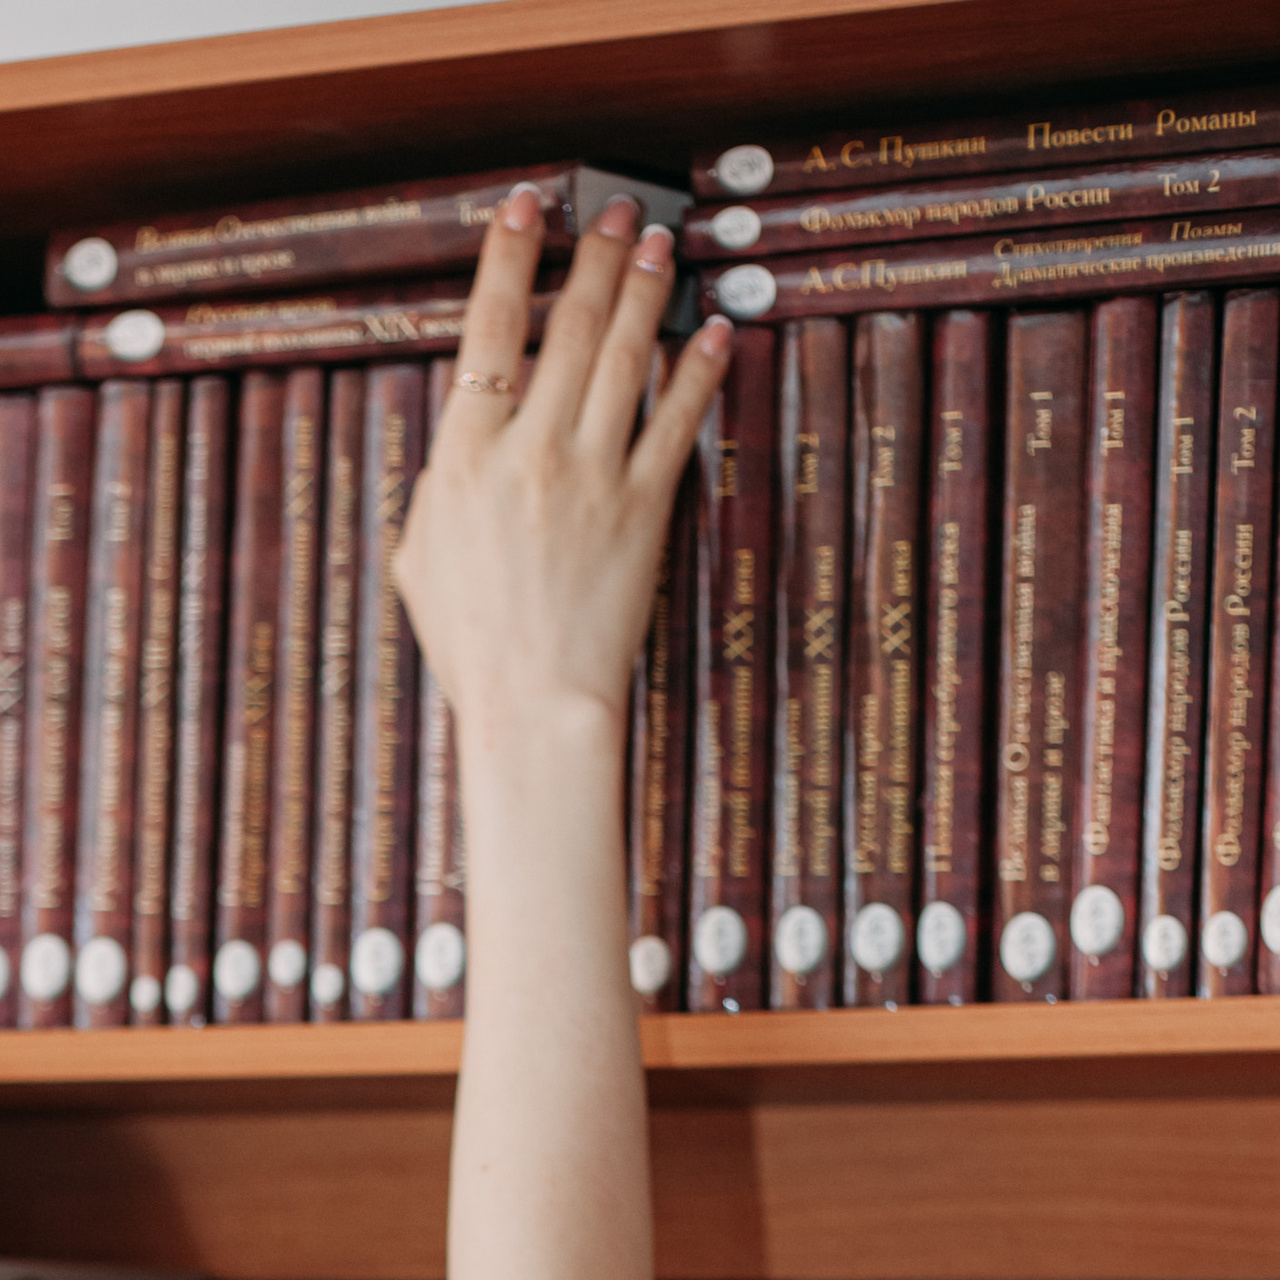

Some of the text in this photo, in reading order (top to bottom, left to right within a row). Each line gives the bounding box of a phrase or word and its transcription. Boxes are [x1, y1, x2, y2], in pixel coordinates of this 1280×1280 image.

[802, 135, 986, 173] А. С. Пушкин
[1027, 109, 1257, 150] Повести Романы
[800, 184, 1111, 232] Фольклор народов России
[1157, 169, 1221, 197] Том 2
[993, 220, 1243, 258] Стихотворения Поэмы
[992, 256, 1141, 288] Драматические
[870, 425, 896, 441] 2
[1025, 391, 1054, 456] Том 1
[1099, 390, 1126, 457] Том 1
[1168, 416, 1195, 482] Том 1
[1229, 406, 1257, 476] Том 2
[937, 427, 963, 478] Том
[722, 609, 755, 660] XX
[802, 607, 835, 658] XX
[878, 602, 913, 655] XX
[1158, 529, 1194, 871] Фольклор народов России
[1214, 522, 1255, 866] Фольклор народов России
[1081, 700, 1117, 855] Фантастика
